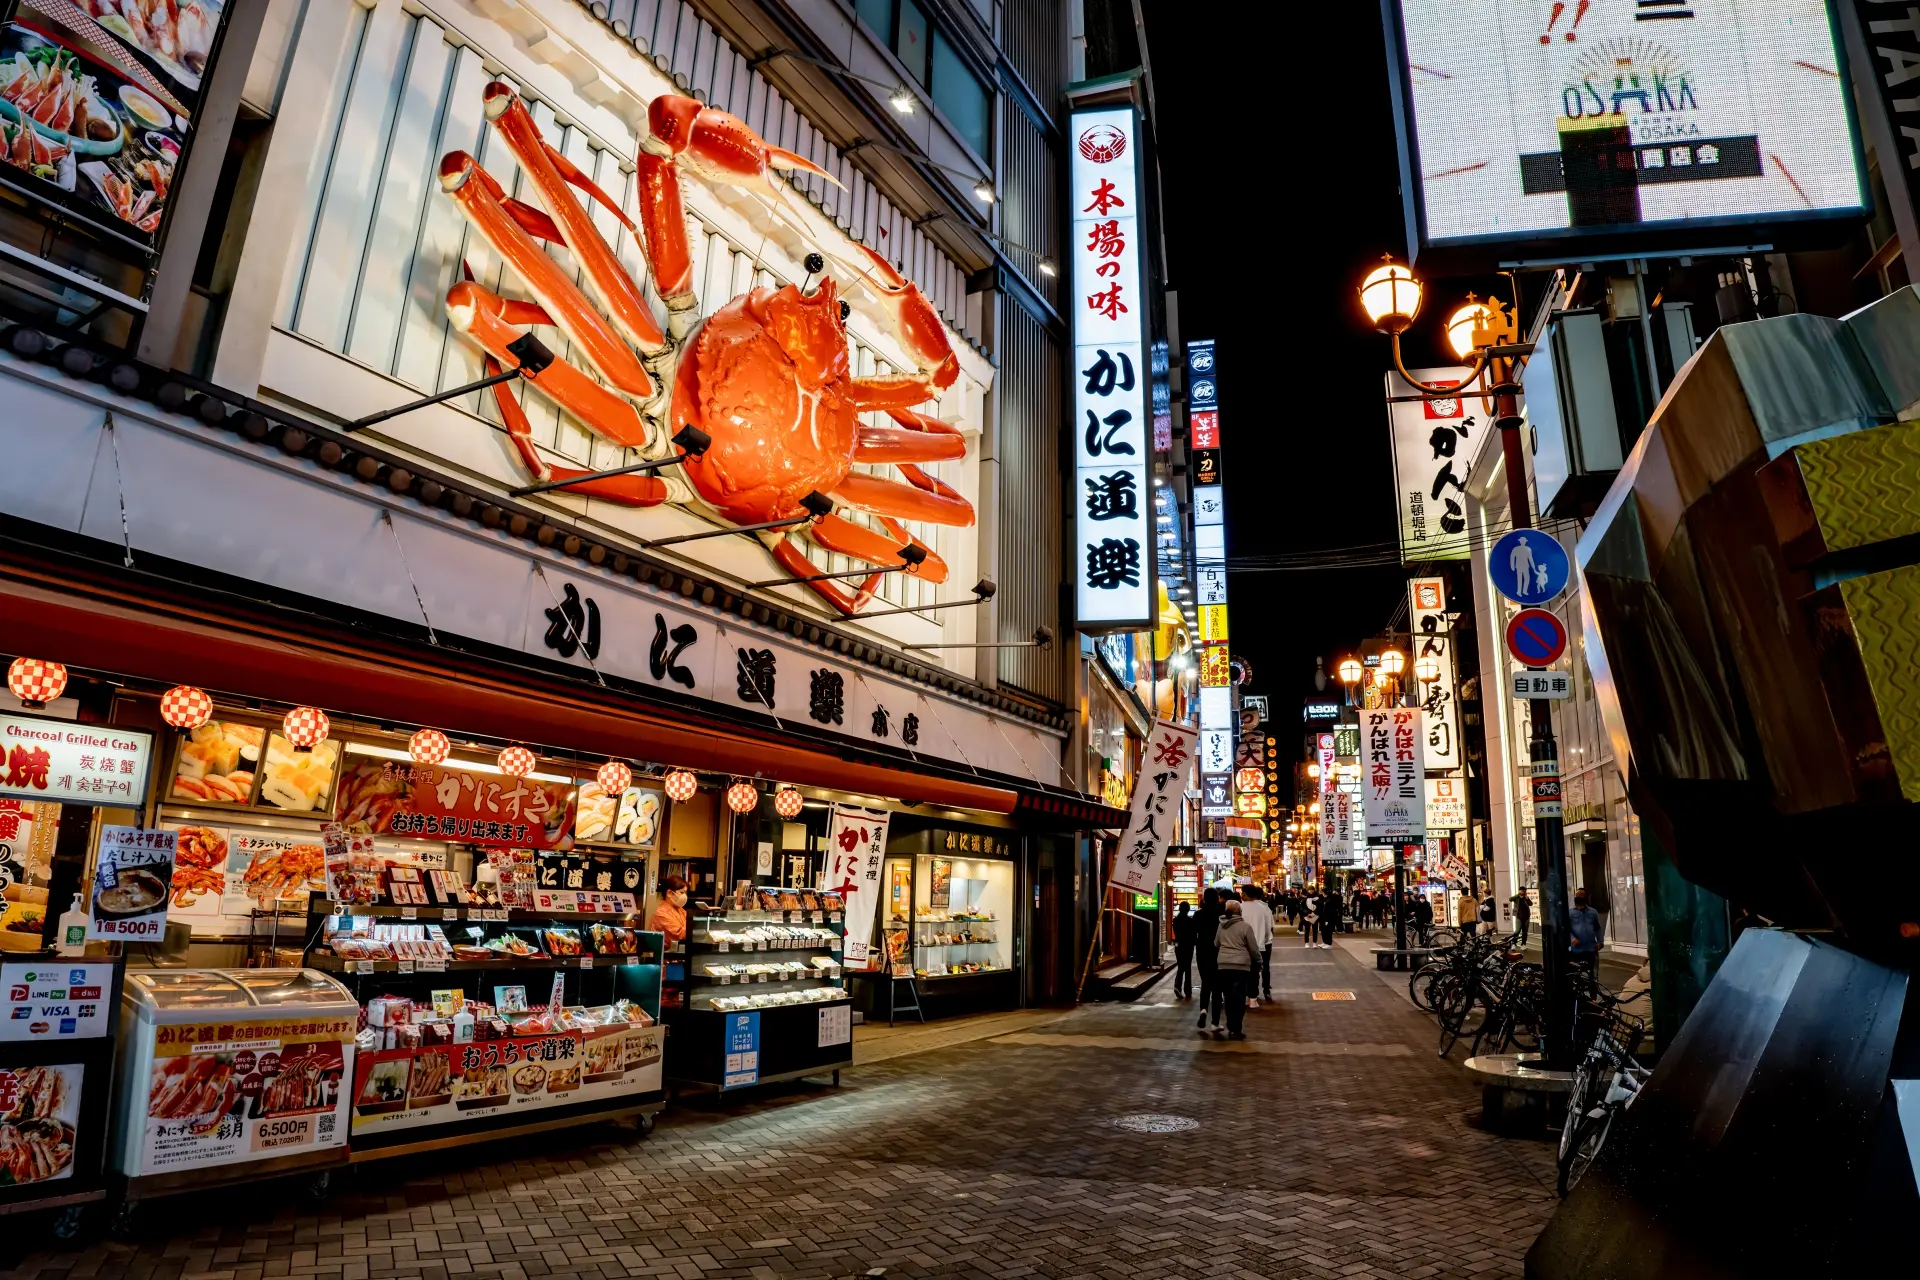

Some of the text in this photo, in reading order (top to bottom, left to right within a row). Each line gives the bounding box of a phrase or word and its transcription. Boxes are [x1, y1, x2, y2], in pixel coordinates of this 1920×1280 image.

[1563, 72, 1699, 119] OSAKA
[1083, 178, 1129, 321] 本場の味
[1409, 491, 1427, 542] 道頓堀店
[1420, 611, 1451, 757] がん寿司
[1514, 676, 1567, 693] 自動車
[6, 725, 138, 752] Charcoal Grilled Crab
[1369, 712, 1391, 800] がんばれ大阪!!
[1394, 712, 1417, 798] がんばれミナミ
[0, 743, 50, 790] 焼
[58, 774, 72, 790] 게
[380, 760, 435, 785] 看板料理
[435, 772, 550, 824] かにすき
[1126, 732, 1189, 869] 活かに入荷
[1337, 793, 1349, 841] がんばれミナミ
[391, 812, 533, 843] お持ち帰り出来ます。
[1324, 793, 1336, 843] がんばれ大阪!!
[105, 830, 174, 849] かにみそ甲羅焼
[106, 849, 168, 864] だし汁入り
[238, 837, 293, 850] 活タラバかに
[411, 852, 443, 863] 活毛かに
[865, 826, 882, 881] 看板料理
[41, 1006, 70, 1016] VISA
[216, 1122, 244, 1140] 彩月
[259, 1120, 308, 1138] 6,500円
